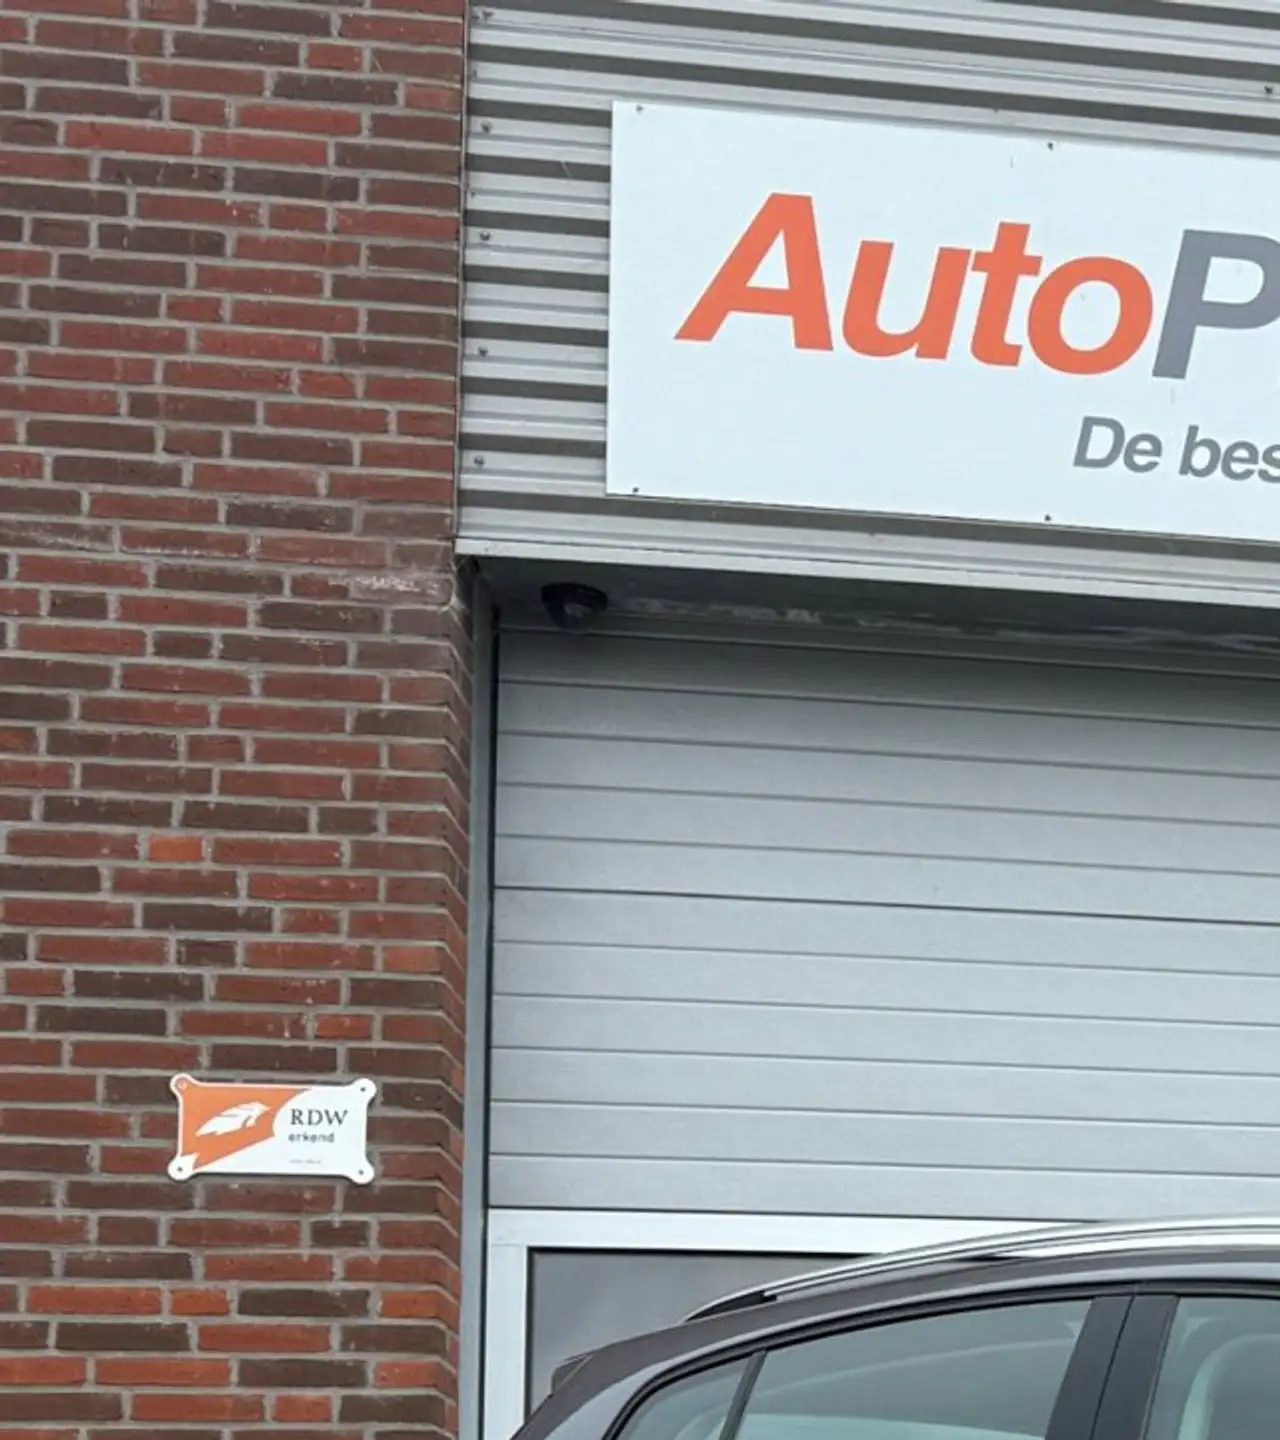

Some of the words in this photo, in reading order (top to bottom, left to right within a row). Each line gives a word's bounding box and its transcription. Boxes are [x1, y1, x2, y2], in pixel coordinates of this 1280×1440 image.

[1074, 416, 1162, 473] De
[290, 1108, 348, 1126] RDW
[288, 1131, 335, 1143] erkend
